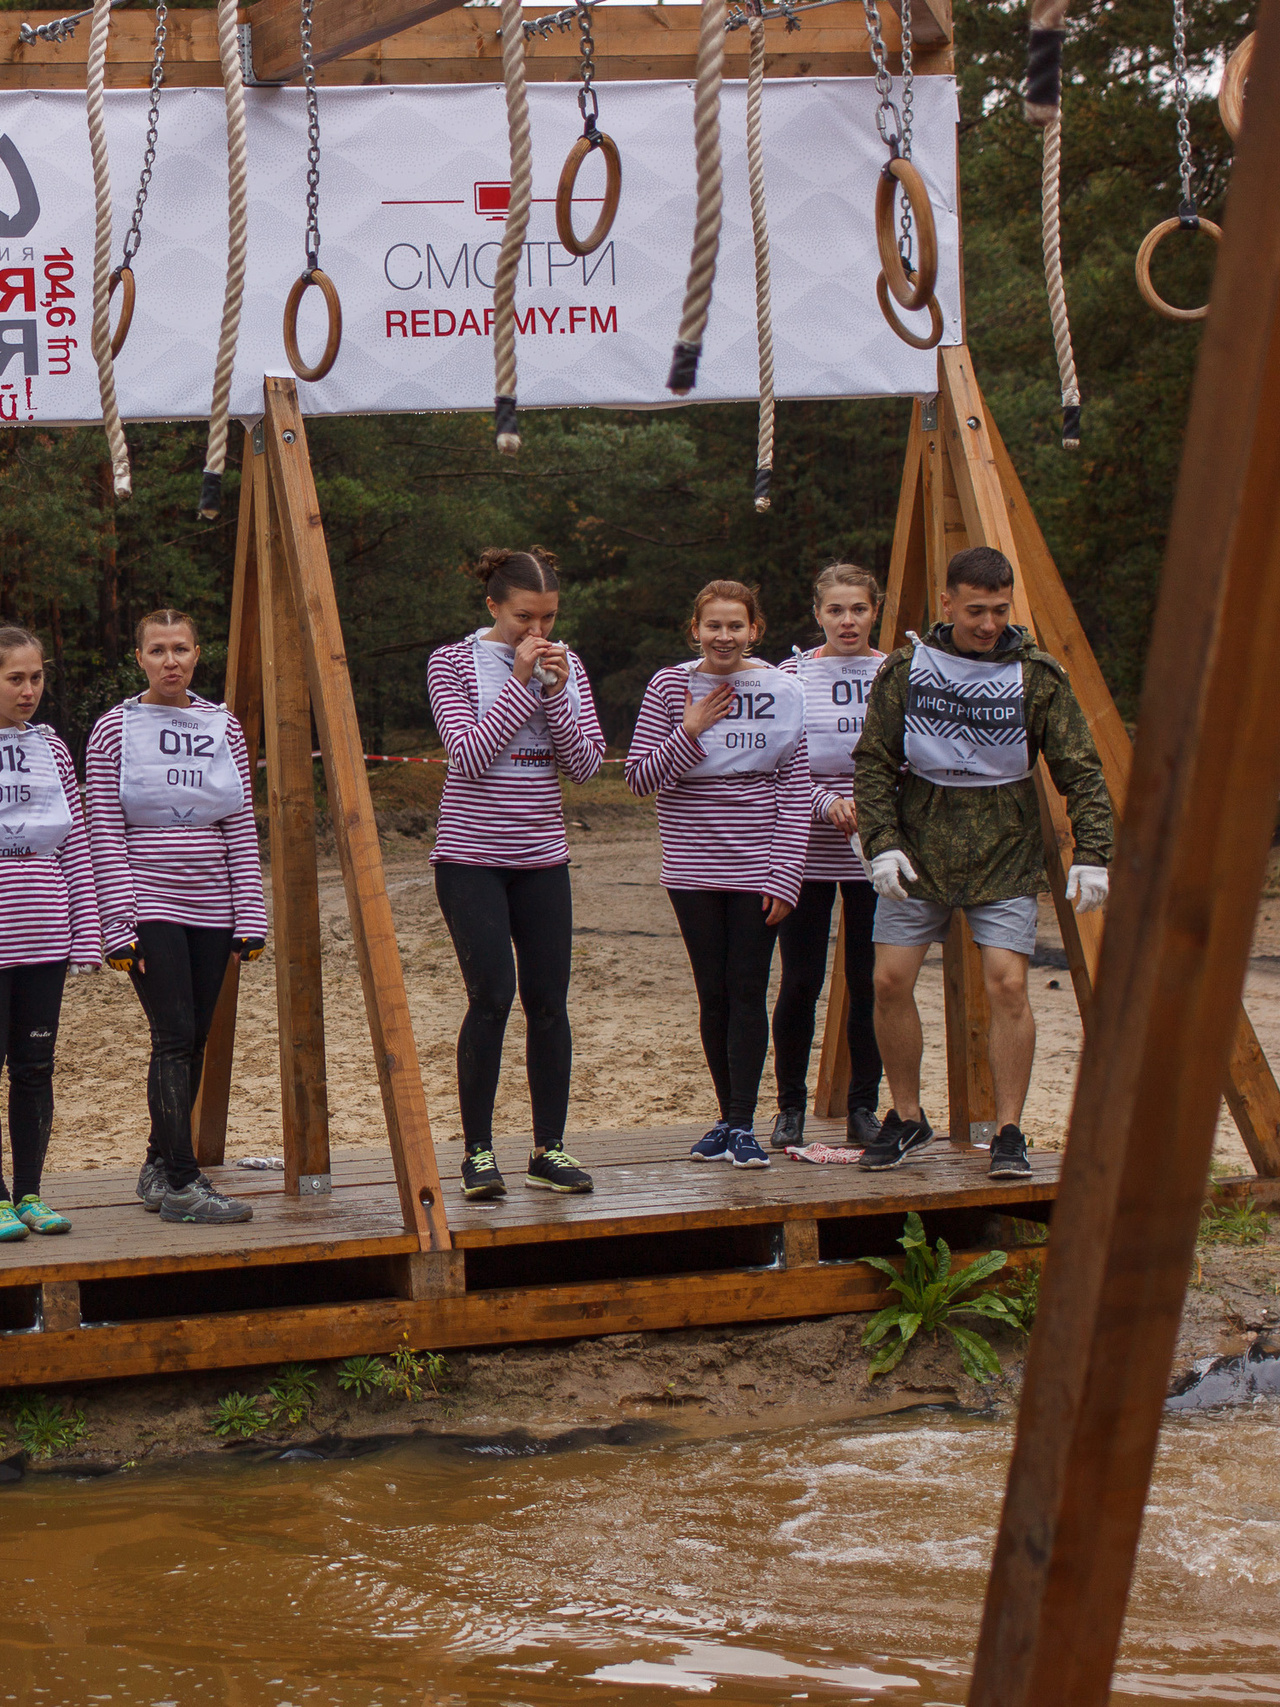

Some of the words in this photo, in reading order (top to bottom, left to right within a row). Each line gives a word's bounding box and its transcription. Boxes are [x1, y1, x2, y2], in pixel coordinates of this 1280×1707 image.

[384, 241, 616, 291] СМОТРИ
[41, 247, 76, 328] 104,6
[47, 335, 78, 375] fm
[172, 719, 199, 730] Взвод
[159, 729, 214, 758] 012
[725, 733, 766, 749] 0118
[167, 769, 203, 787] 0111
